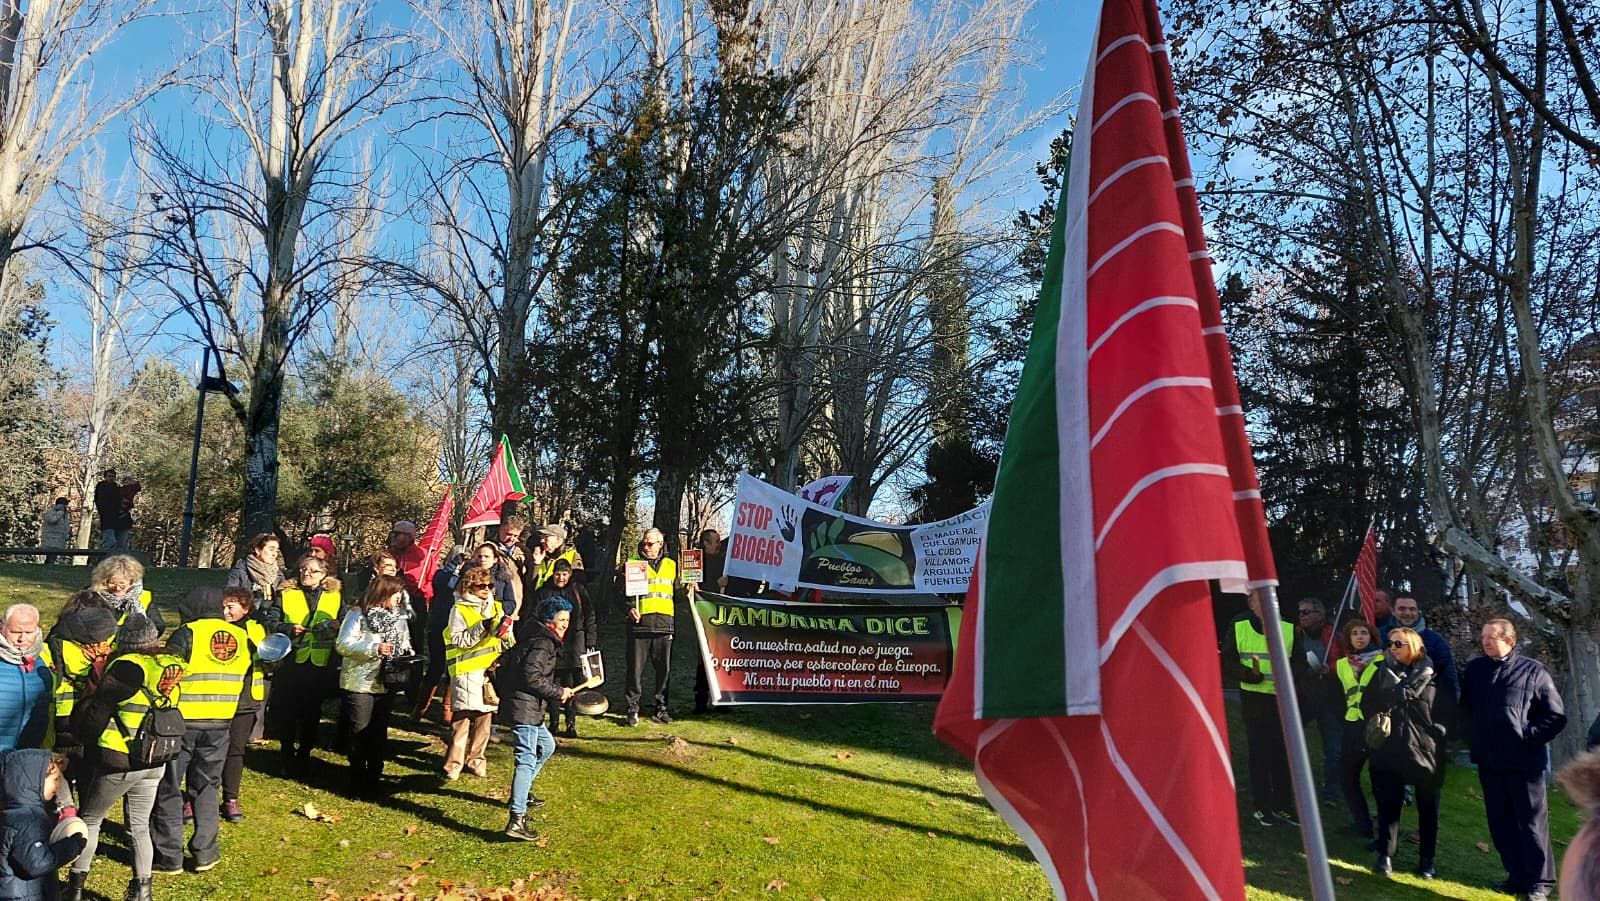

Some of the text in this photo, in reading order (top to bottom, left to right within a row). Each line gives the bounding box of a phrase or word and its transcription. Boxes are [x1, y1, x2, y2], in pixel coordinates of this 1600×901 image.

[737, 501, 773, 530] STOP
[934, 527, 977, 539] MADERAL
[731, 533, 785, 567] BIOGÁS
[938, 547, 962, 556] CUBO
[817, 557, 863, 573] Pueblos
[925, 557, 970, 566] VILLAMOR
[839, 572, 875, 586] Sanos
[710, 605, 930, 636] JAMBRINA DICE
[730, 636, 913, 660] Con nuestra salud no se juega.
[721, 657, 782, 672] queremos
[783, 659, 803, 670] ser
[806, 657, 876, 672] estercolero
[878, 659, 894, 672] de
[895, 659, 941, 677] Europa.
[742, 671, 900, 691] Ni en tu pueblo ni en el mío
